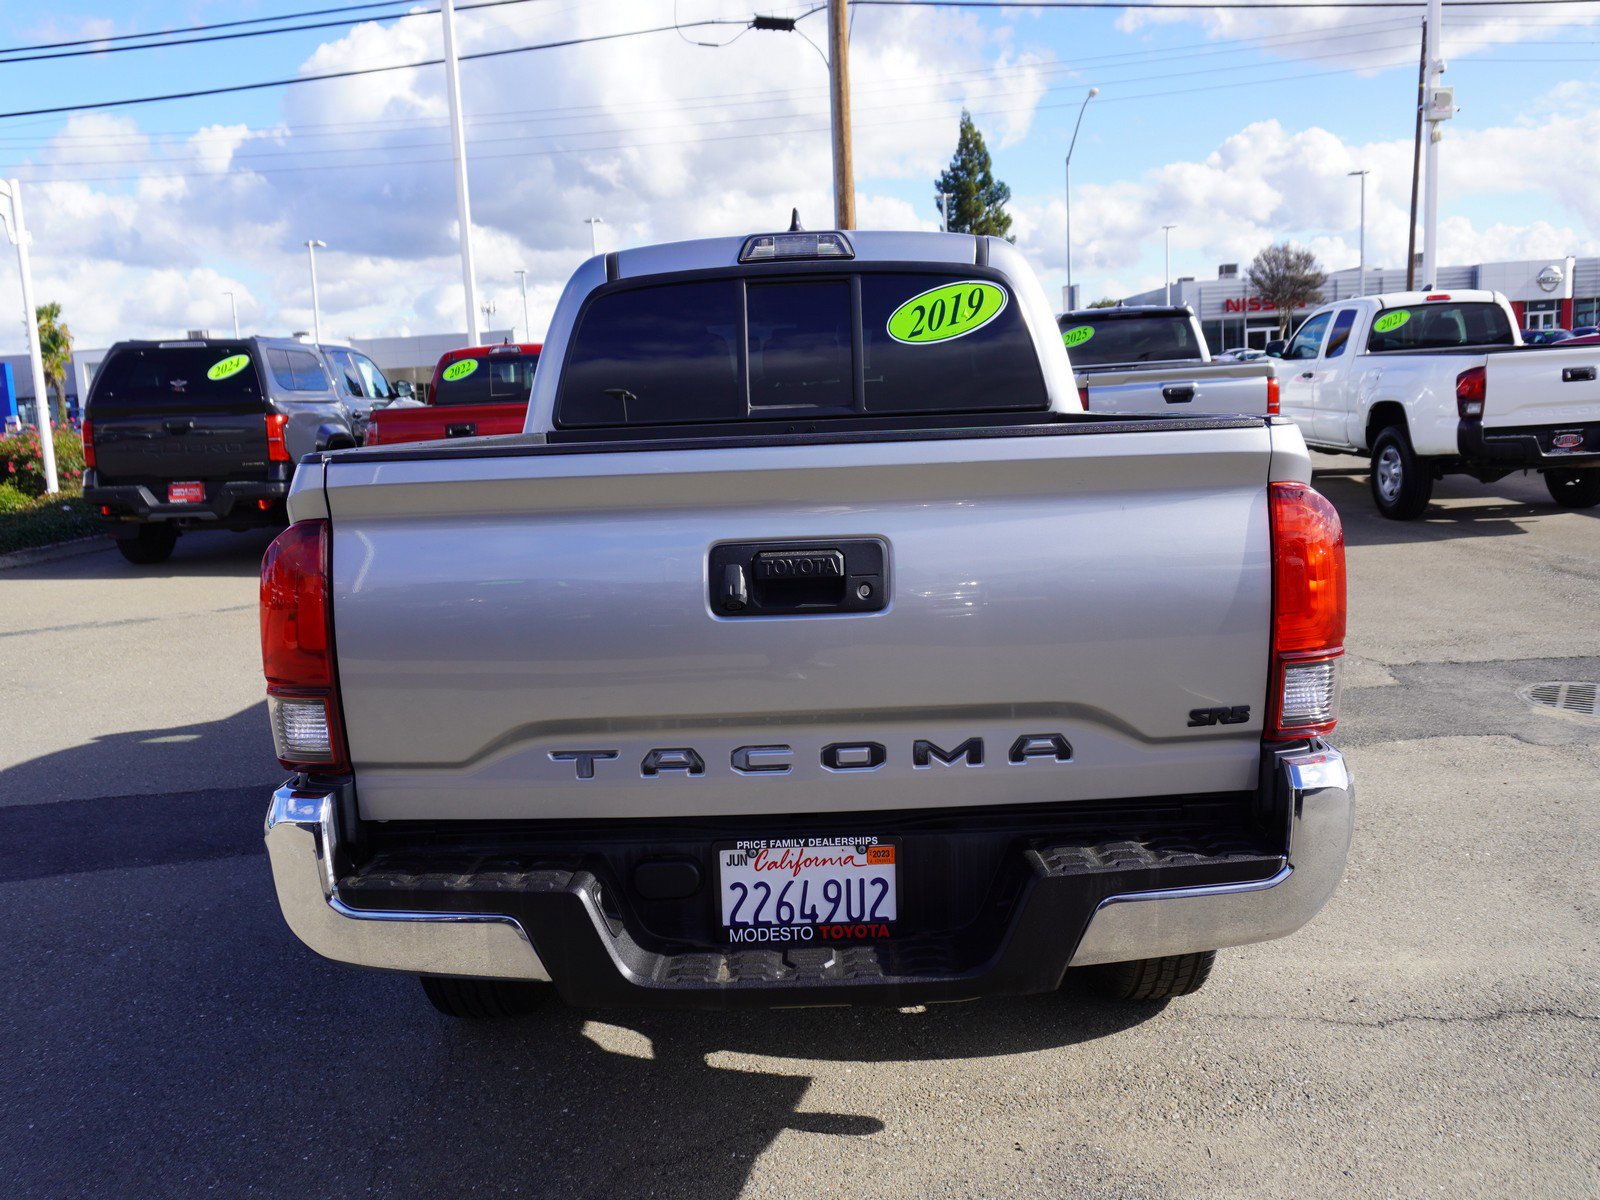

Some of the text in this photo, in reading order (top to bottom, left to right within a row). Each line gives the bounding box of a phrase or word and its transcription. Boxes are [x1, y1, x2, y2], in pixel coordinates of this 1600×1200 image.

[907, 287, 985, 339] 2019
[1225, 297, 1306, 313] NISS
[1380, 312, 1403, 330] 2021
[1064, 328, 1088, 346] 2025
[214, 357, 241, 378] 2024
[449, 361, 472, 379] 2022
[761, 557, 839, 577] TOYOTA
[1187, 705, 1251, 727] SR5
[547, 732, 1074, 780] TACOMA
[736, 836, 878, 850] PRICE FAMILY DEALERSHIPS
[726, 854, 748, 867] JUN
[753, 848, 868, 877] California
[872, 849, 890, 858] 2023
[729, 877, 890, 926] 22649U2
[729, 924, 890, 943] MODESTO TOYOTA
